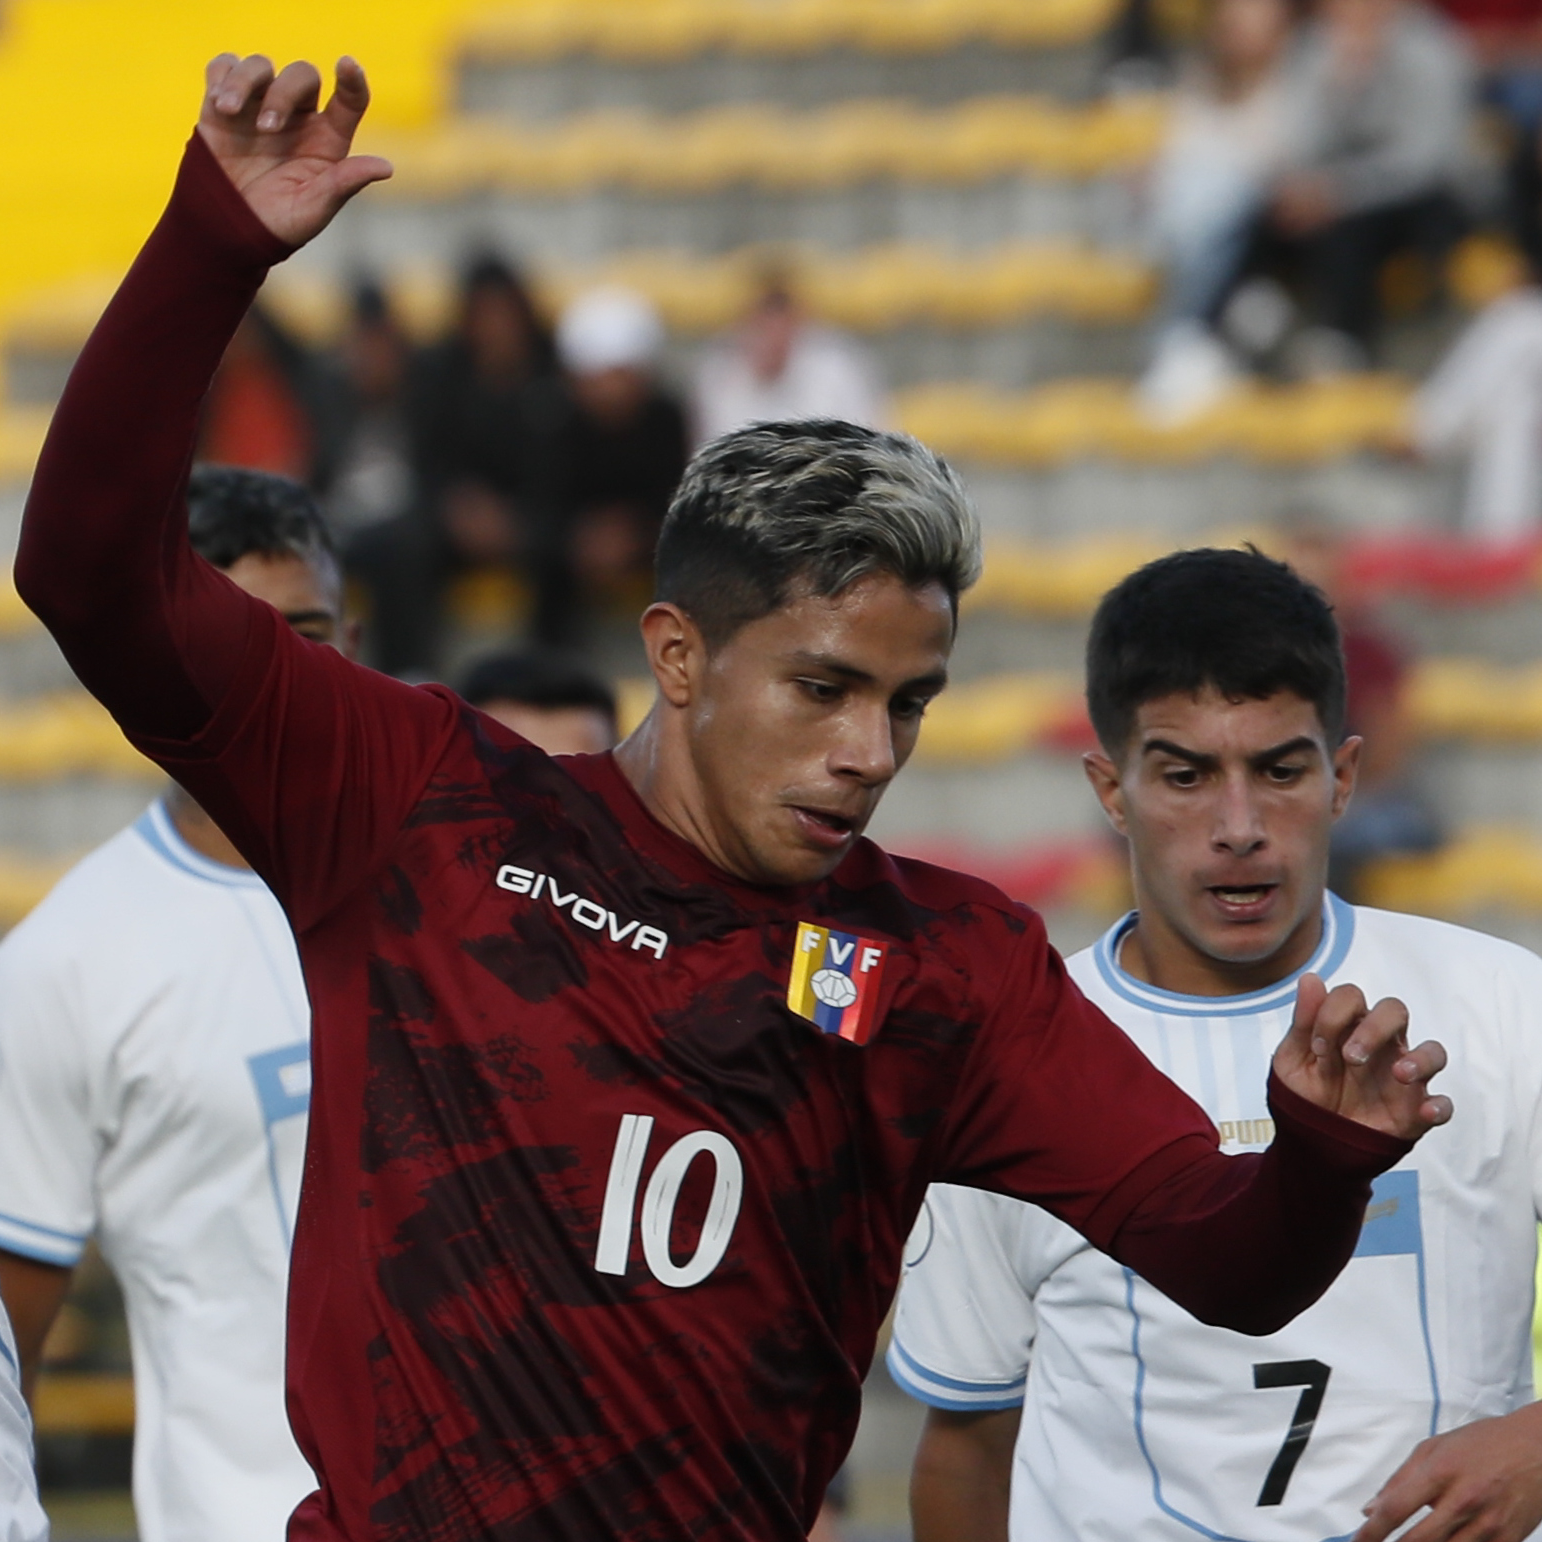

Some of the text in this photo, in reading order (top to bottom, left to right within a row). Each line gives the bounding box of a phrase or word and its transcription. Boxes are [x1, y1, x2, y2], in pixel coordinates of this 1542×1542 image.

[495, 864, 669, 959] GIVOVA
[801, 930, 882, 973] FVF
[1219, 1118, 1276, 1145] PUM
[594, 1113, 744, 1288] 10
[1253, 1358, 1332, 1507] 7
